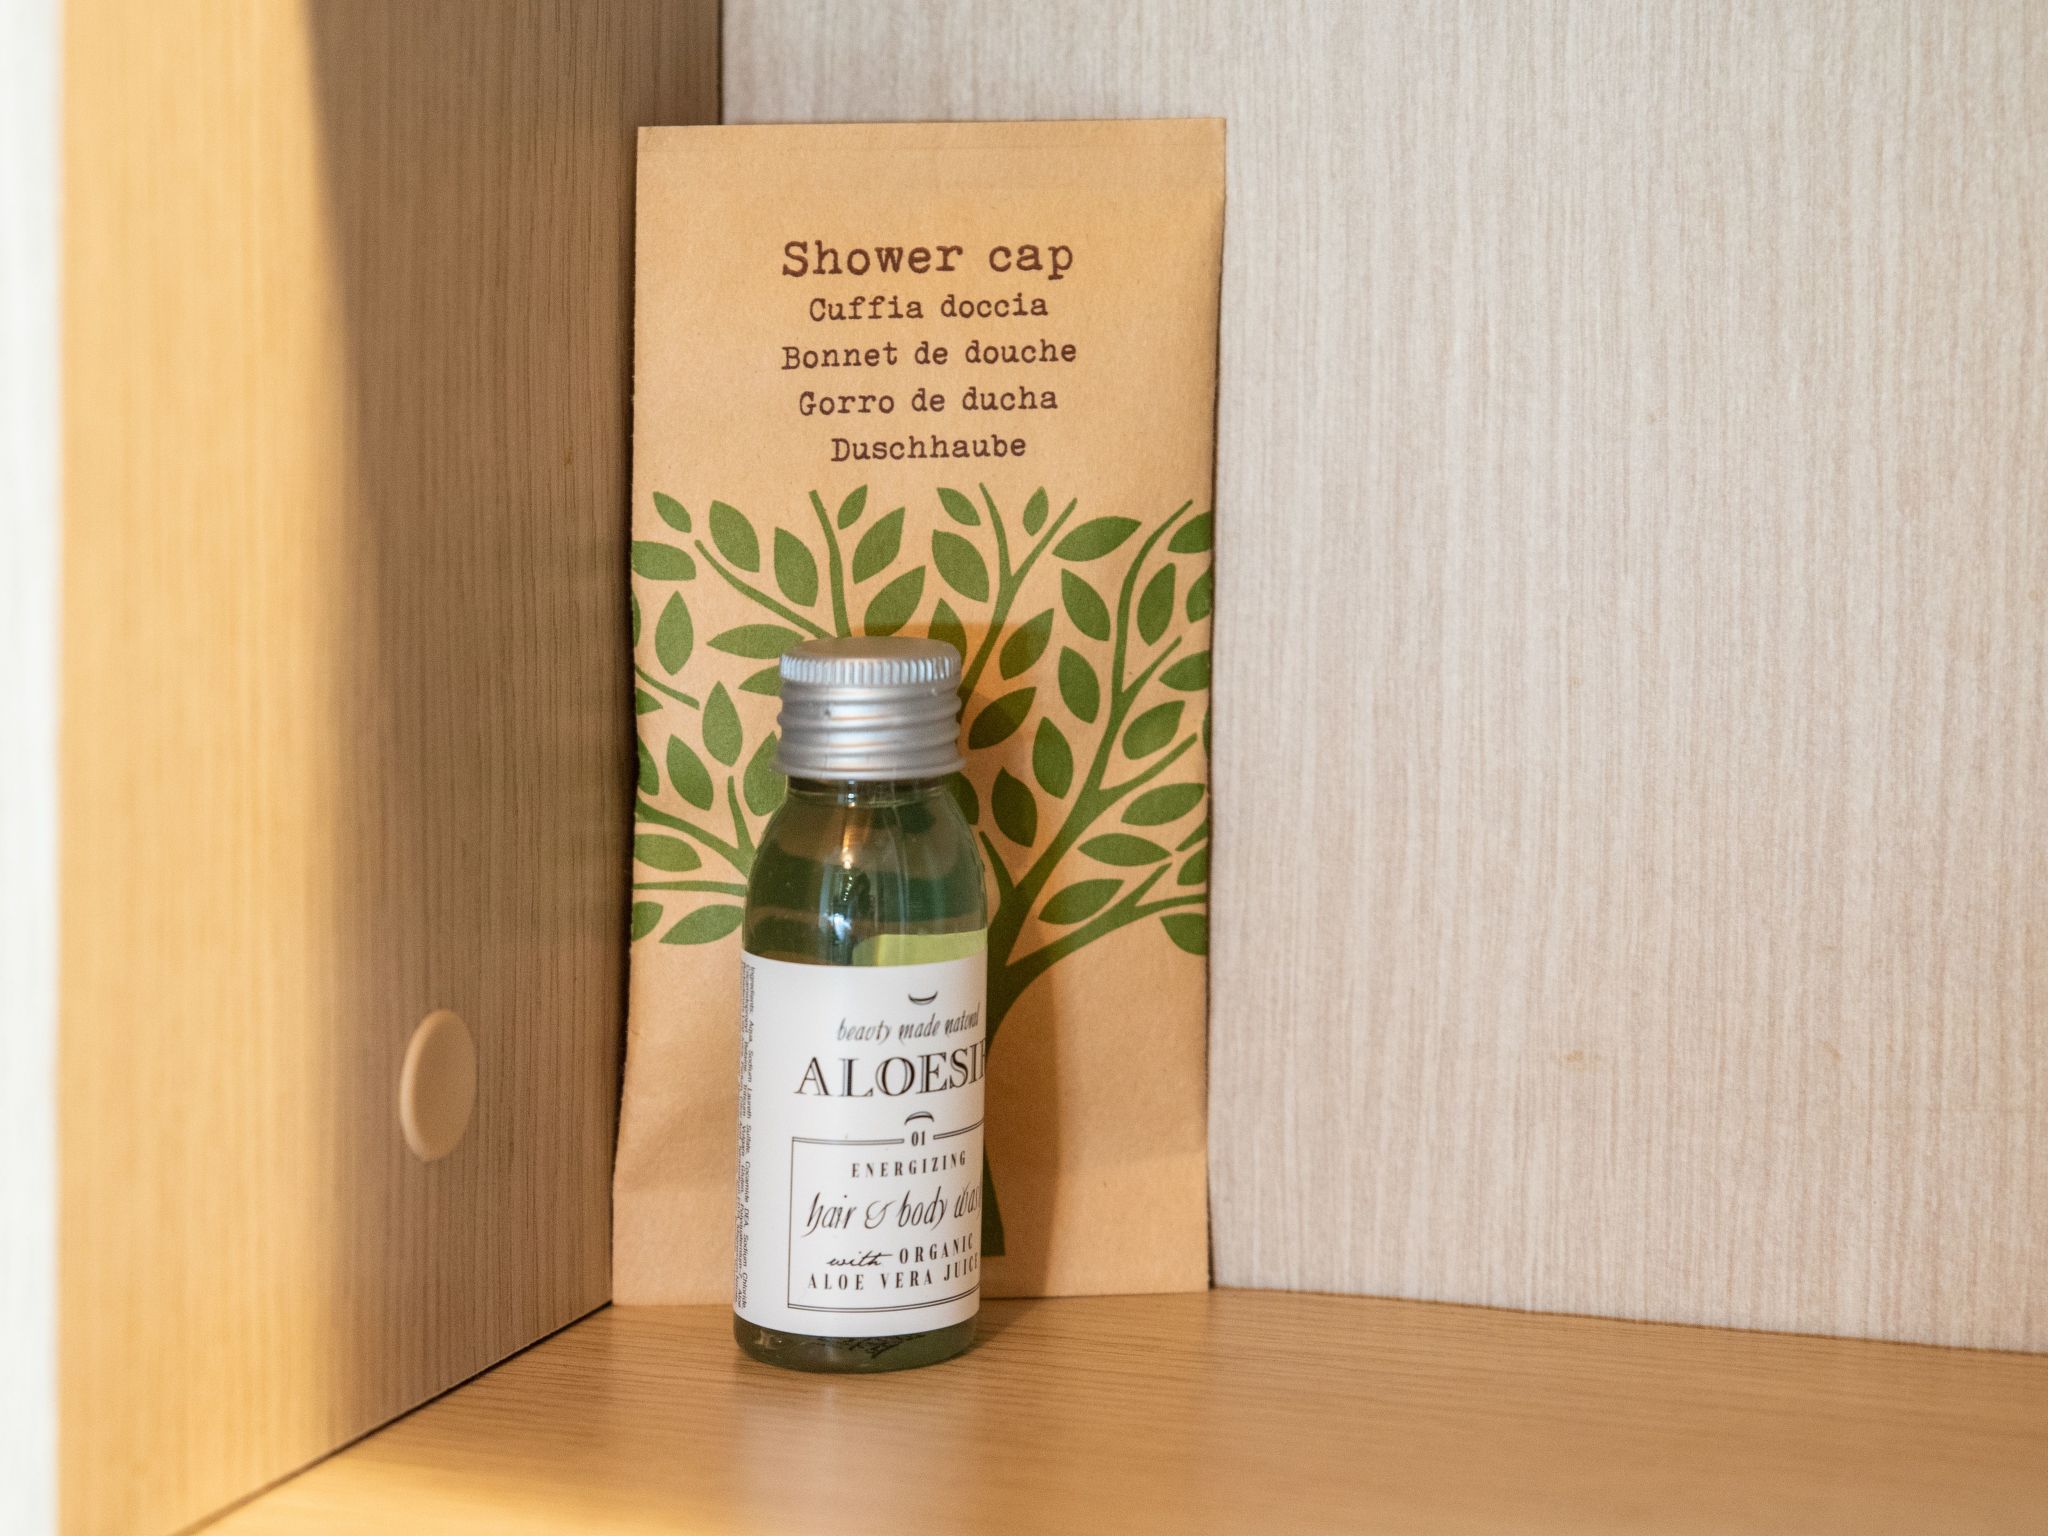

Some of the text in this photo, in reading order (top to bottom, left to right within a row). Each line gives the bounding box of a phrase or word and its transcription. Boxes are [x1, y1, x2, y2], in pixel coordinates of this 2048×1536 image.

[782, 240, 1074, 280] Shower cap
[809, 292, 1049, 322] Cuffia doccia
[781, 339, 1077, 370] Bonnet de douche
[799, 386, 1059, 416] Gorro de ducha
[830, 434, 1027, 462] Duschhaube
[836, 1017, 892, 1045] beauty
[898, 1012, 941, 1045] made
[851, 1150, 967, 1178] ENERGIZING
[801, 1191, 857, 1238] hair
[864, 1200, 897, 1229] &
[897, 1185, 949, 1231] body
[826, 1232, 974, 1267] with ORGANIC
[807, 1251, 979, 1291] ALOE VERA JUICE
